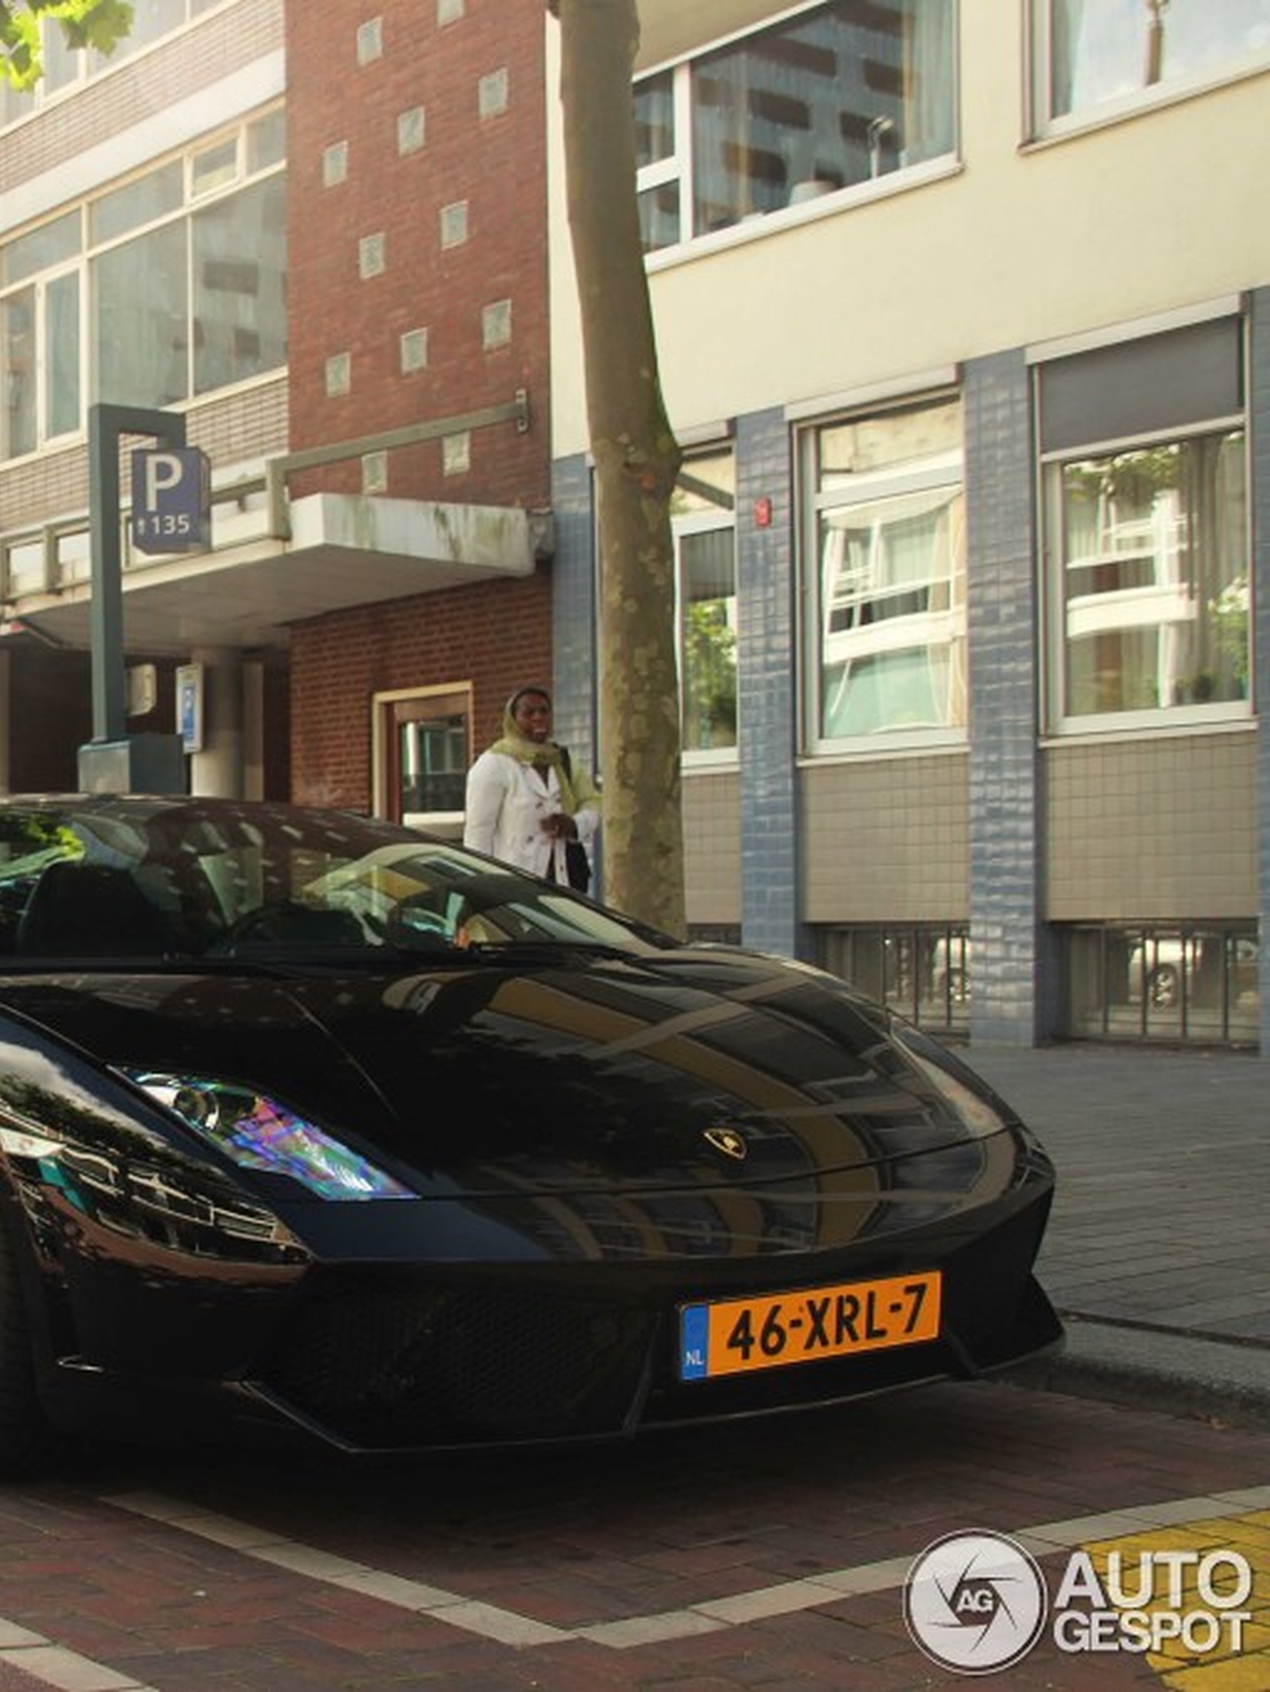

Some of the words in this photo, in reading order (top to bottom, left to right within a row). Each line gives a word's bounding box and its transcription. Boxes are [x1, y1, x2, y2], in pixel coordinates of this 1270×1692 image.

[146, 454, 183, 512] P
[151, 514, 190, 535] 135
[727, 1283, 928, 1360] 46-XRL-7
[686, 1350, 704, 1367] NL
